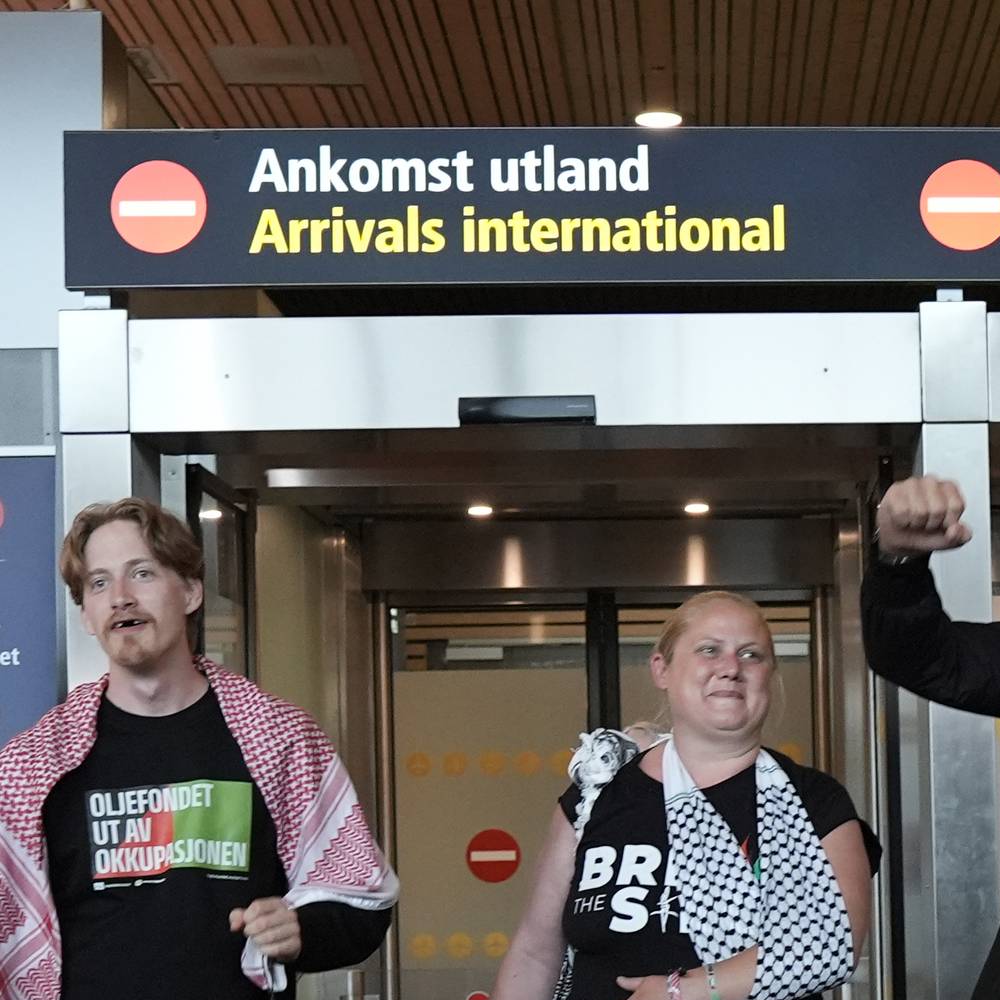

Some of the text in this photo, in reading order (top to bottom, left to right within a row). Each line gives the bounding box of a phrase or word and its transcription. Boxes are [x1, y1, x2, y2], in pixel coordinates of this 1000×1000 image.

[249, 145, 650, 193] Ankomst utland
[249, 205, 785, 254] Arrivals international
[89, 784, 214, 818] OLJEFONDET
[92, 817, 152, 846] UT AV
[94, 838, 248, 875] OKKUPASJONEN
[574, 894, 607, 914] THE
